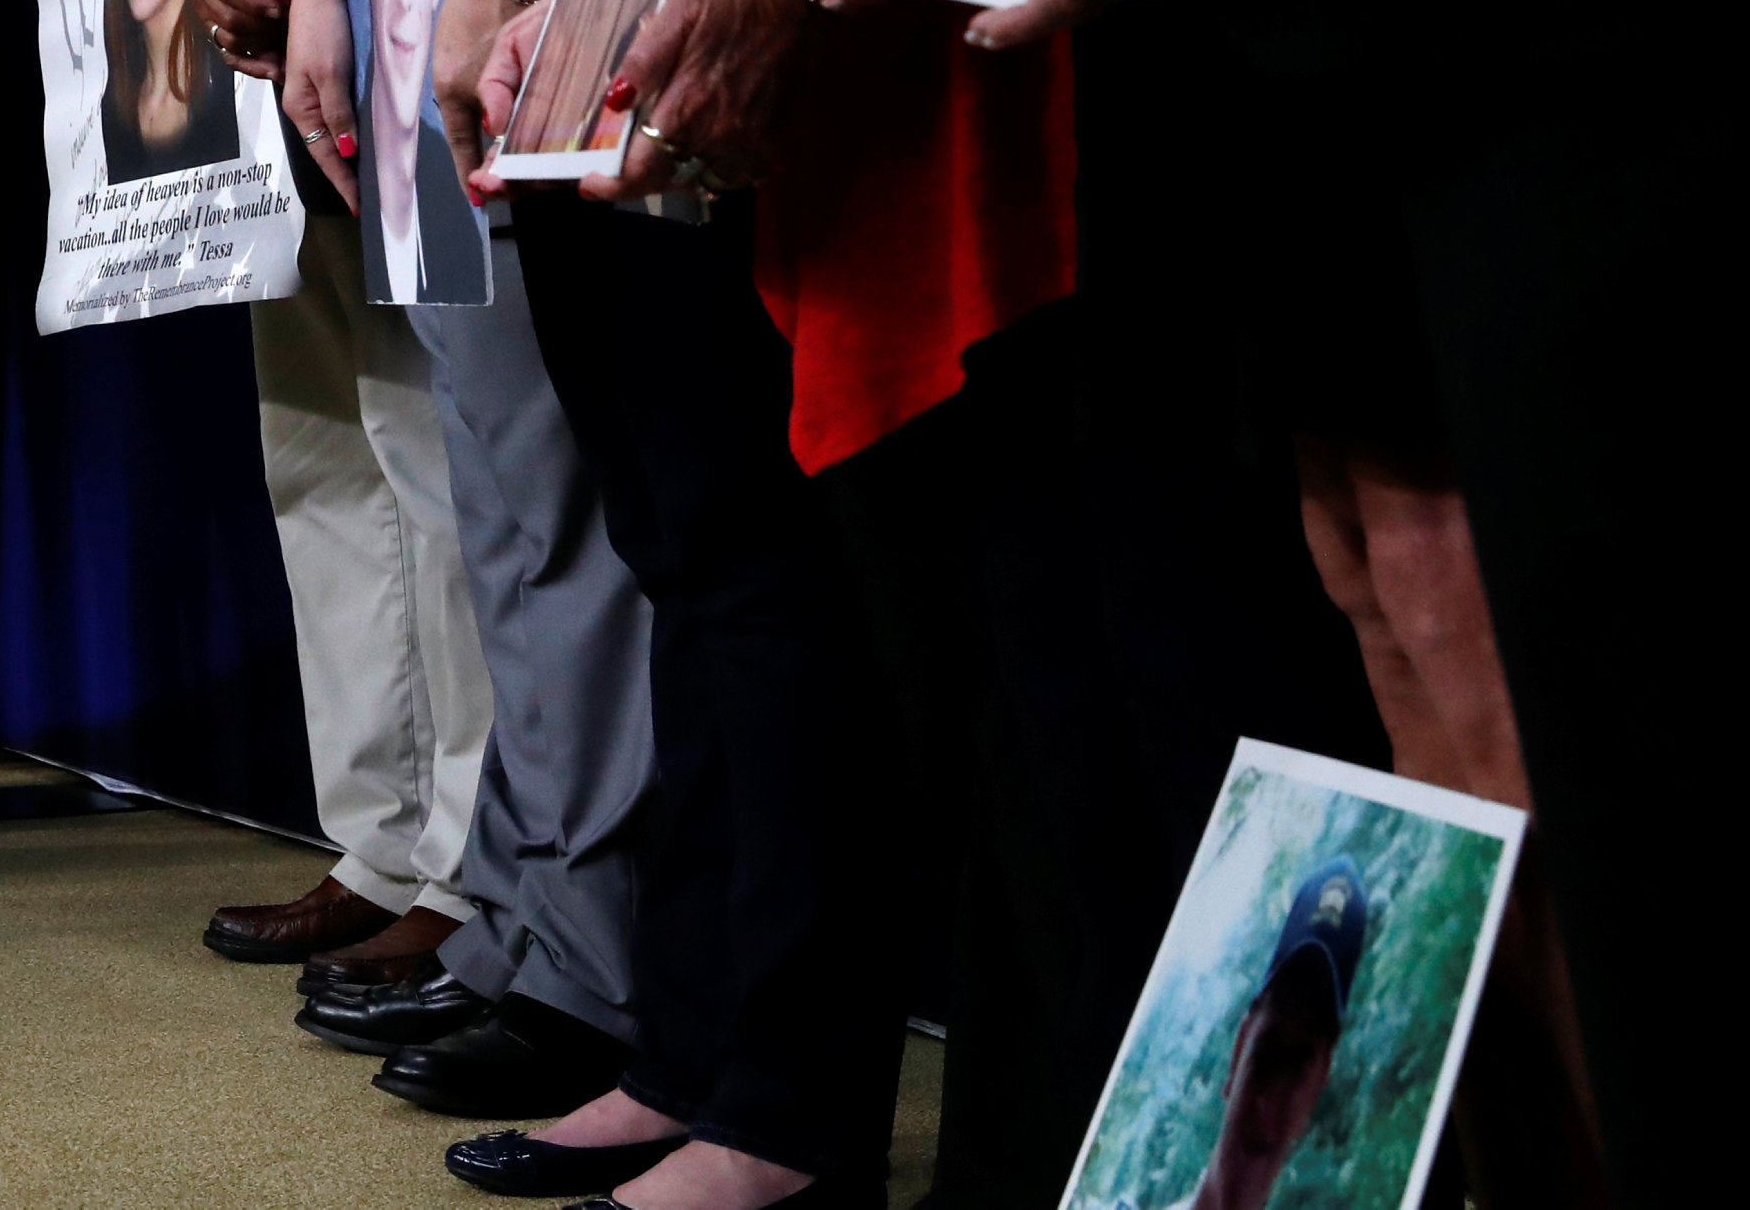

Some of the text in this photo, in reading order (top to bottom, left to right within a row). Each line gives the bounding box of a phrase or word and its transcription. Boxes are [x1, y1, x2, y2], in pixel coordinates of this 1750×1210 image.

[103, 190, 129, 212] idea
[131, 182, 145, 211] of
[146, 179, 191, 204] heaven
[192, 174, 203, 194] is
[207, 175, 214, 191] a
[218, 161, 272, 188] non-stop
[130, 218, 148, 240] the
[151, 211, 191, 242] people
[193, 207, 202, 230] I
[204, 205, 230, 228] love
[233, 196, 271, 221] would
[274, 191, 291, 214] be
[98, 257, 129, 280] there
[131, 251, 159, 274] with
[200, 240, 234, 264] Tessa
[63, 272, 253, 314] Memorialized by TheRemembranceProject.org
